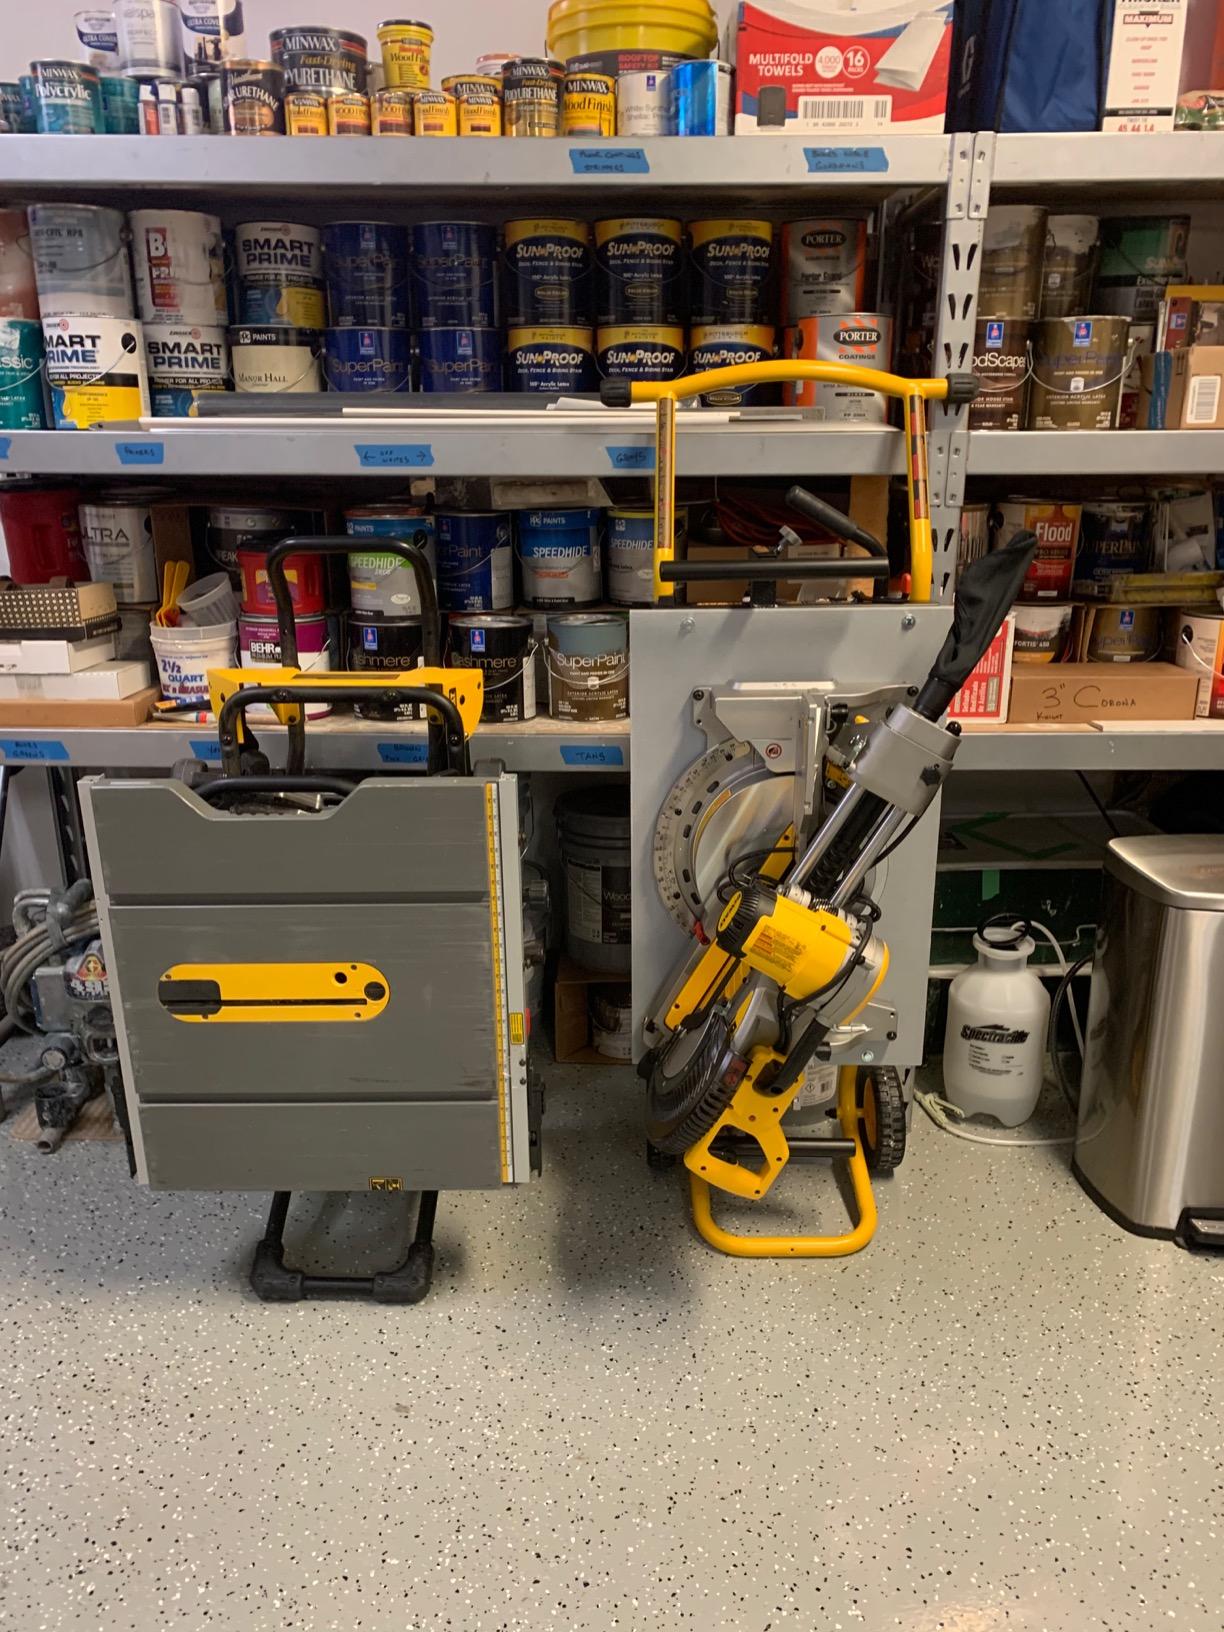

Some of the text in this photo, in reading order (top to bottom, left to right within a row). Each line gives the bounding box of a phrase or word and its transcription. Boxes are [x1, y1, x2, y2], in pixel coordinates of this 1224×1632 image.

[285, 36, 337, 51] MINWAX
[749, 53, 813, 65] MULTIFOLD
[847, 51, 865, 66] 16
[512, 67, 547, 78] MINWAX
[758, 65, 803, 77] TOWELS
[284, 68, 356, 90] YURETHANE
[35, 83, 92, 100] Polycrylic
[457, 83, 496, 95] MINWAX
[504, 87, 557, 101] POLYURETHANE
[567, 81, 608, 94] MINWAX
[237, 85, 279, 111] URETHANE
[587, 97, 613, 113] Finish
[806, 233, 843, 243] PORTER
[243, 238, 314, 254] SMART
[516, 244, 583, 259] SUN PROOF
[607, 242, 675, 257] SUN PROOF
[707, 243, 730, 257] SUN
[246, 253, 311, 267] PRIME
[253, 333, 276, 341] PAINTS
[839, 331, 878, 341] PORTER
[148, 341, 222, 355] SMART
[0, 354, 34, 369] ssic
[153, 356, 221, 369] PRIME
[516, 351, 583, 365] SUN PROOF
[607, 350, 675, 365] SUN PROOF
[693, 351, 761, 365] SUN PROOF
[264, 373, 288, 382] HALL
[543, 517, 566, 525] PAINTS
[1035, 522, 1073, 541] Flood
[611, 538, 654, 551] SPEEDHIDE
[217, 551, 238, 561] EAK
[532, 545, 588, 559] SPEEDHIDE
[251, 642, 275, 652] BEHR
[557, 652, 626, 670] SuperPaint
[168, 674, 205, 683] QUART
